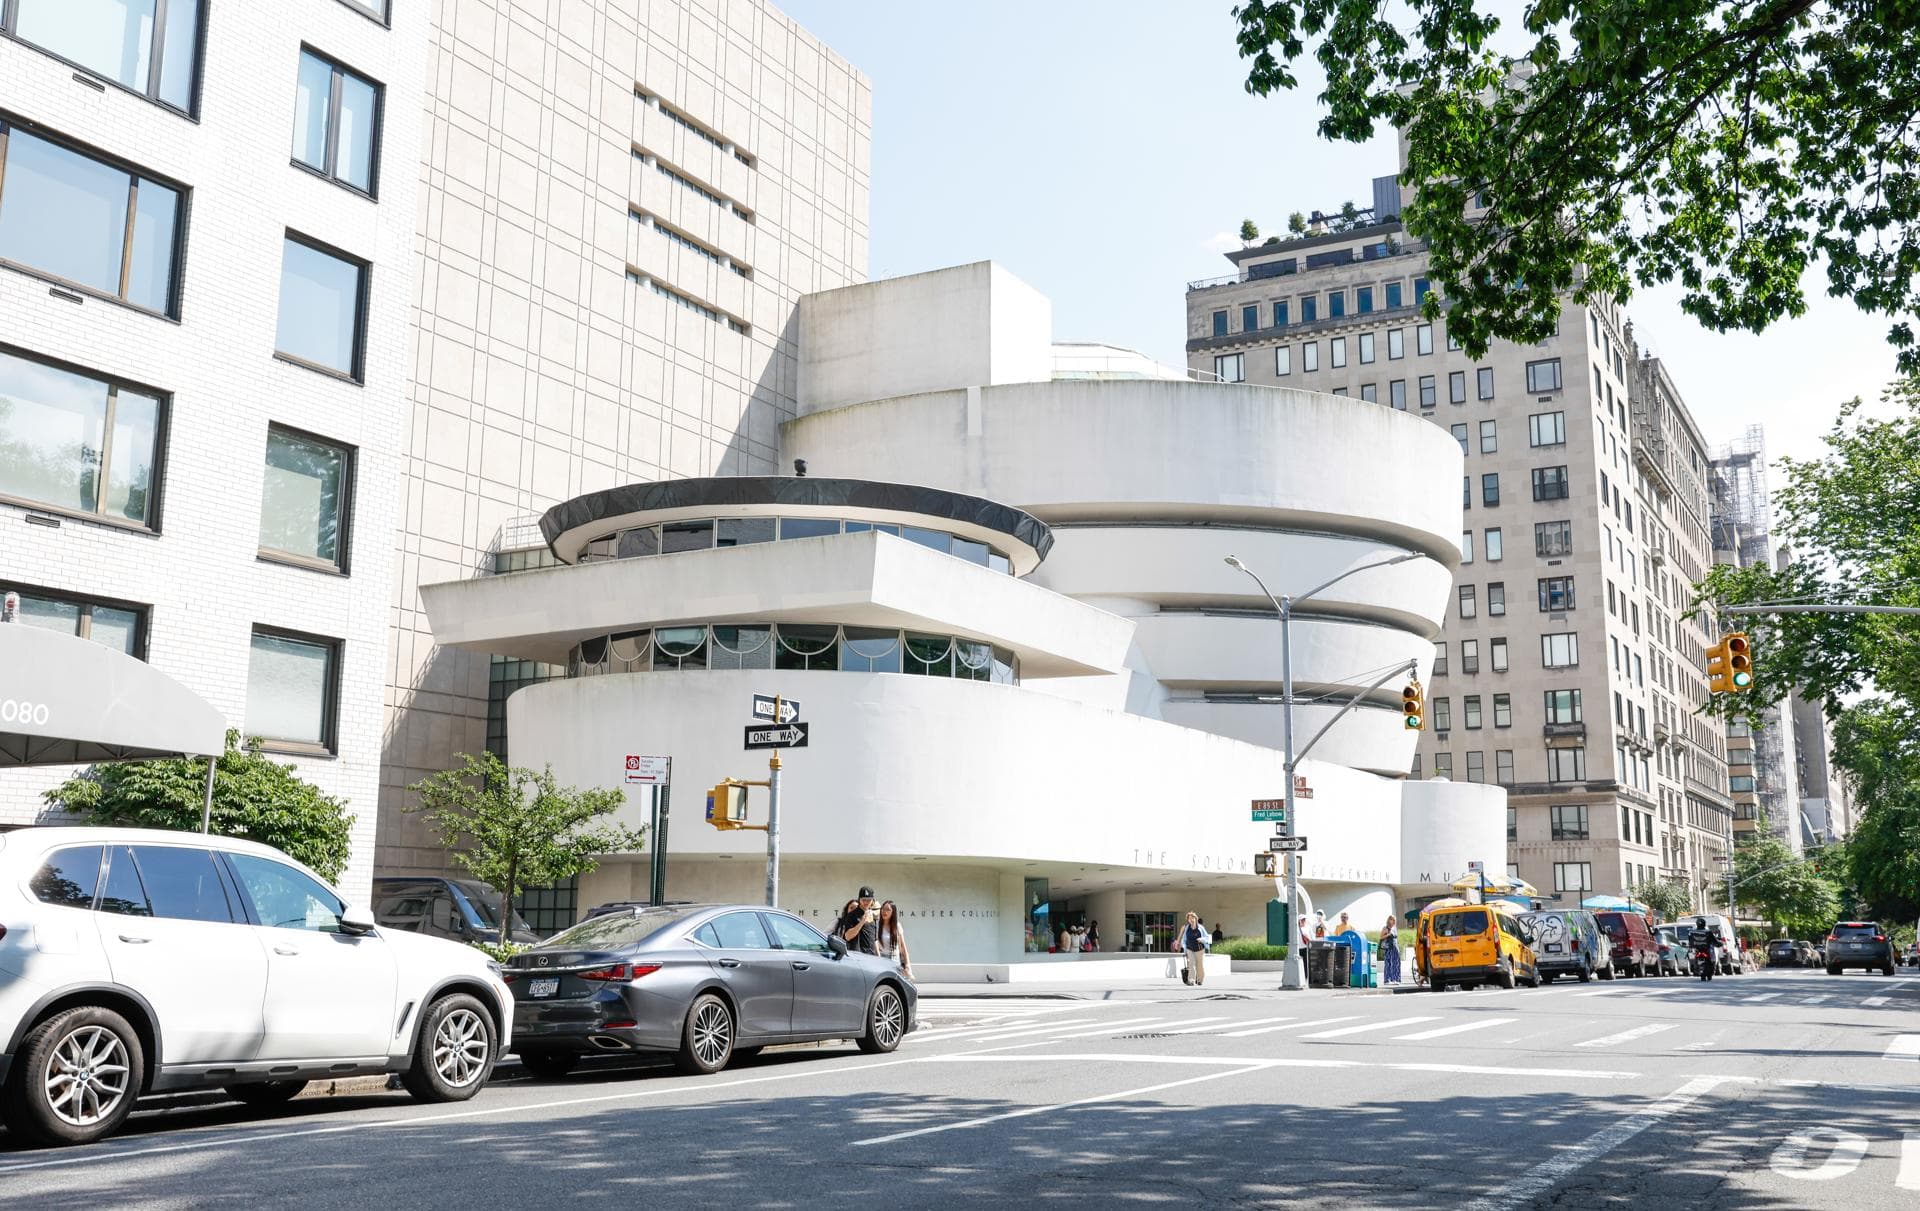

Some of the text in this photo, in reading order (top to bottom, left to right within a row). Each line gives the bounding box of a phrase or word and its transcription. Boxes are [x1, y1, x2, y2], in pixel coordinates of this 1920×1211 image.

[0, 698, 49, 725] 080
[759, 702, 774, 714] ONE
[753, 730, 799, 743] ONE WAY
[1257, 801, 1261, 809] E
[1272, 801, 1279, 809] St
[1134, 848, 1167, 866] THE
[1192, 854, 1247, 873] SOLOM
[787, 909, 820, 917] HE
